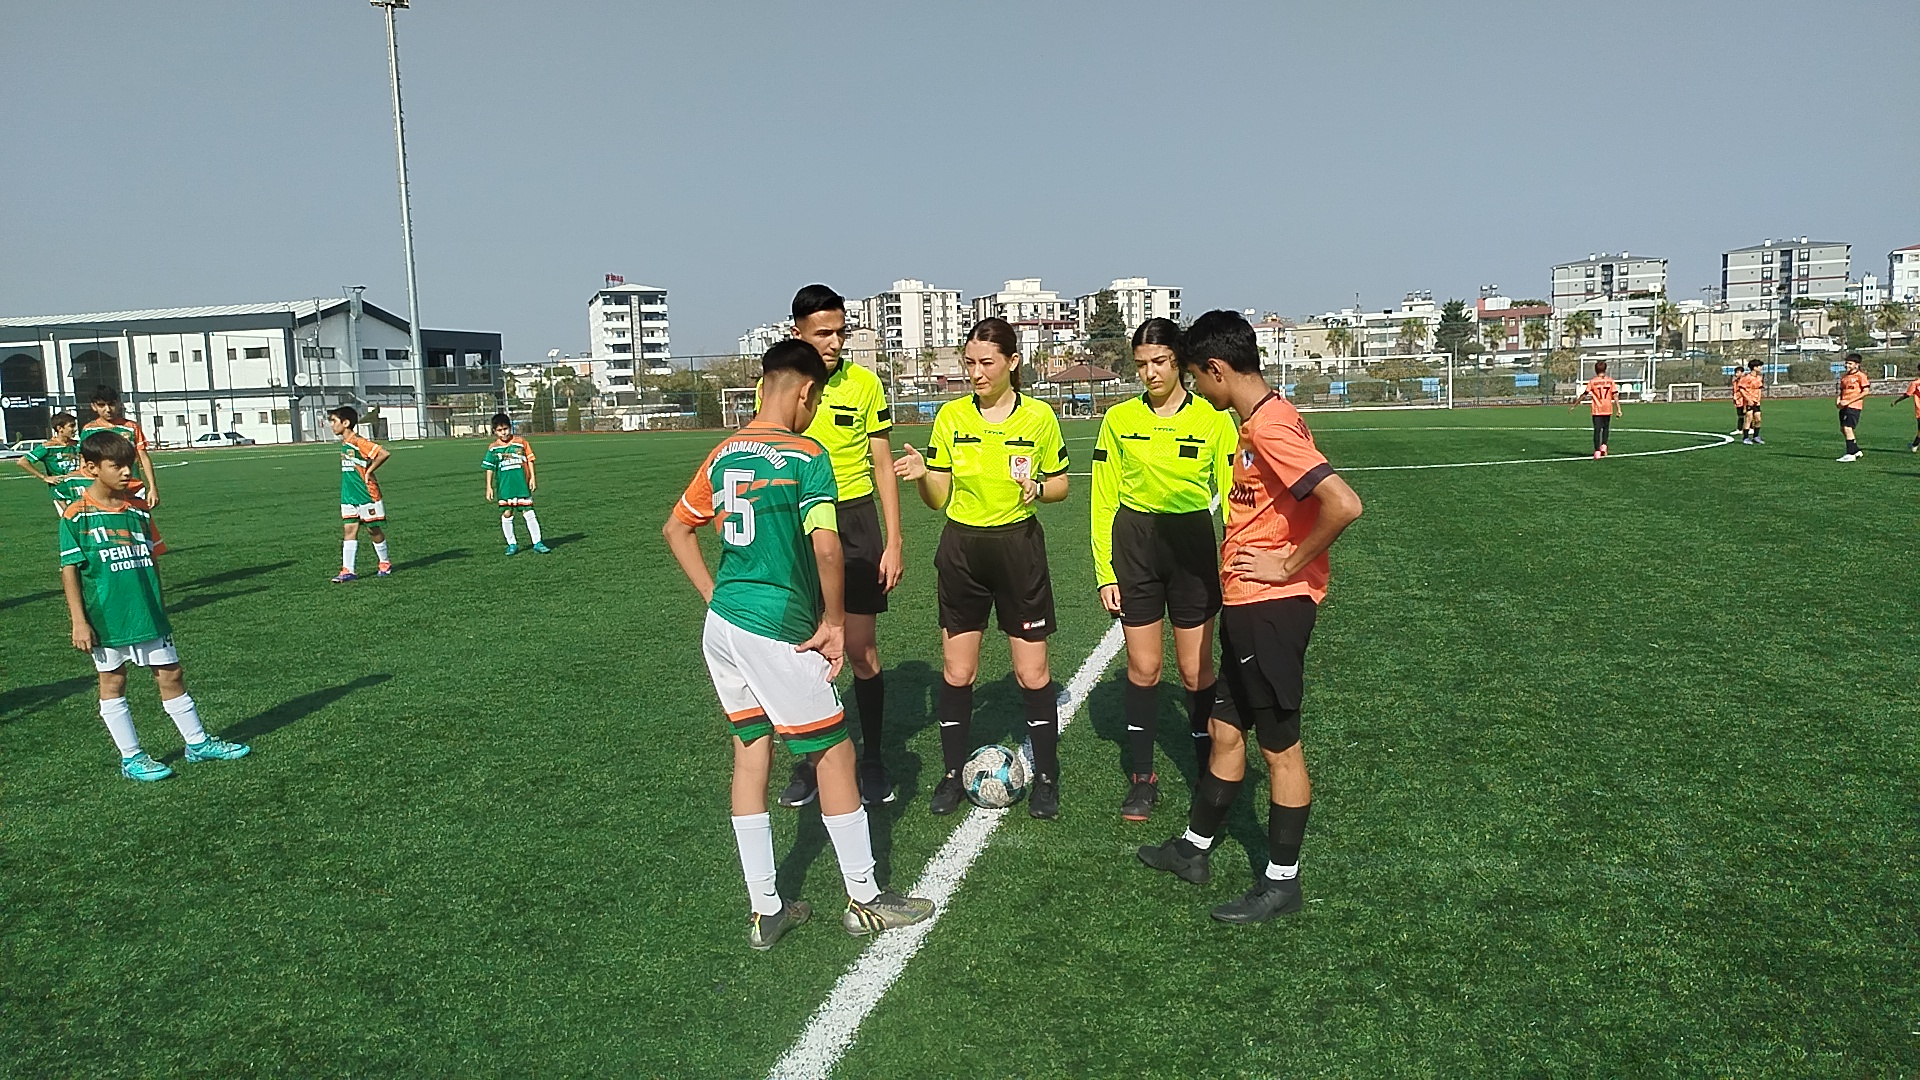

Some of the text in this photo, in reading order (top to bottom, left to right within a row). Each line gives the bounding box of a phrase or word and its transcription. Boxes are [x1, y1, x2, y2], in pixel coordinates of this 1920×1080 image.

[1597, 387, 1610, 399] 17
[724, 469, 755, 546] 5
[89, 526, 109, 544] 11
[99, 543, 151, 563] PEHLA
